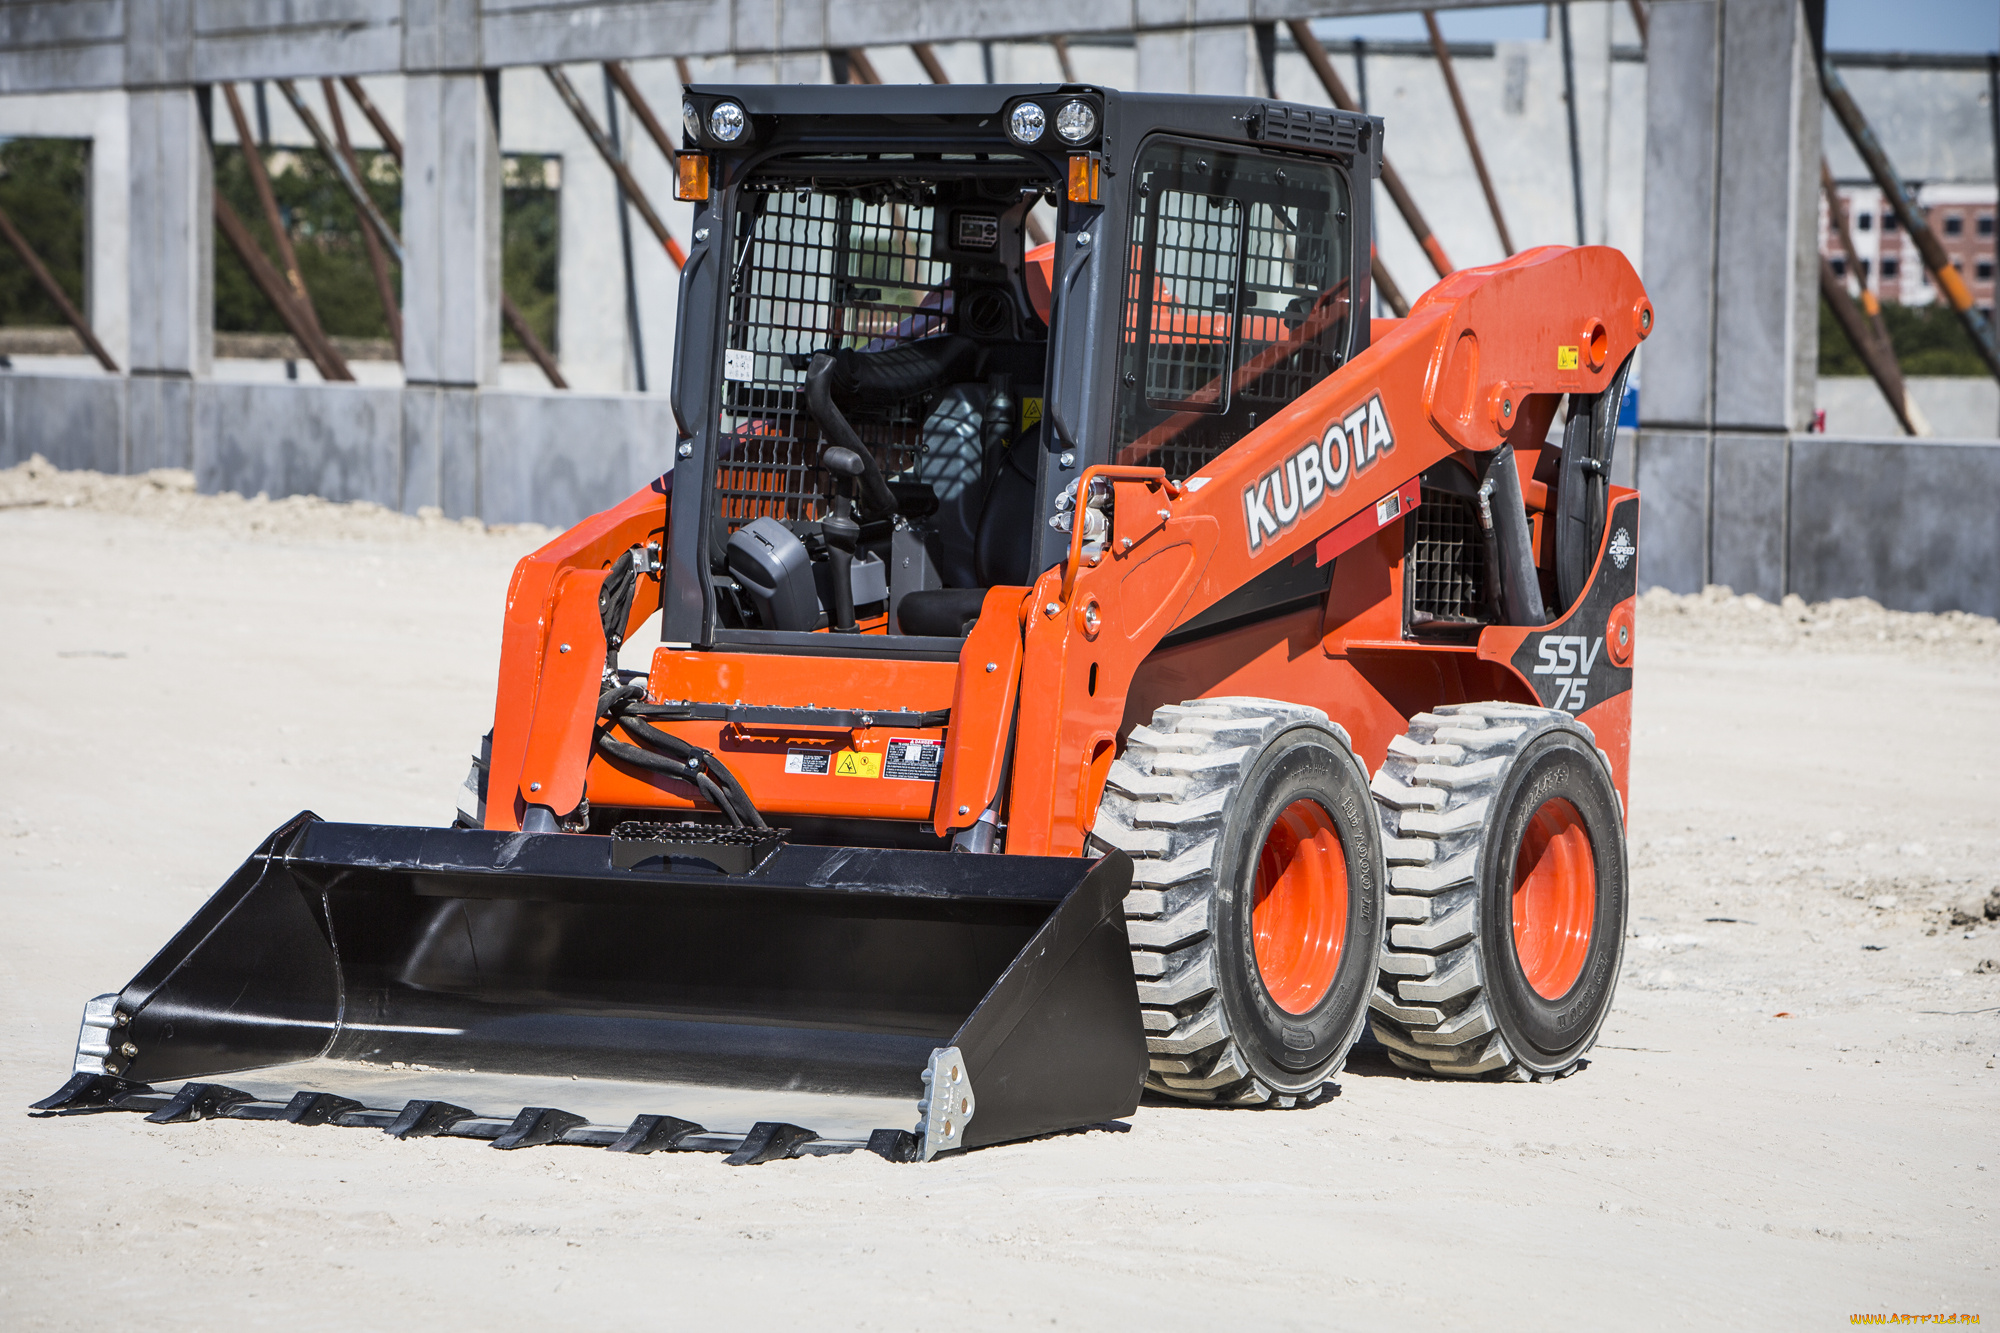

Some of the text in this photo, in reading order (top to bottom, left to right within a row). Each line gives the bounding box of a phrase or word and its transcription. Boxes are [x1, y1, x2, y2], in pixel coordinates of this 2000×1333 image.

[1245, 396, 1393, 549] KUBOTA
[1533, 635, 1603, 675] SSV
[1553, 677, 1588, 710] 75
